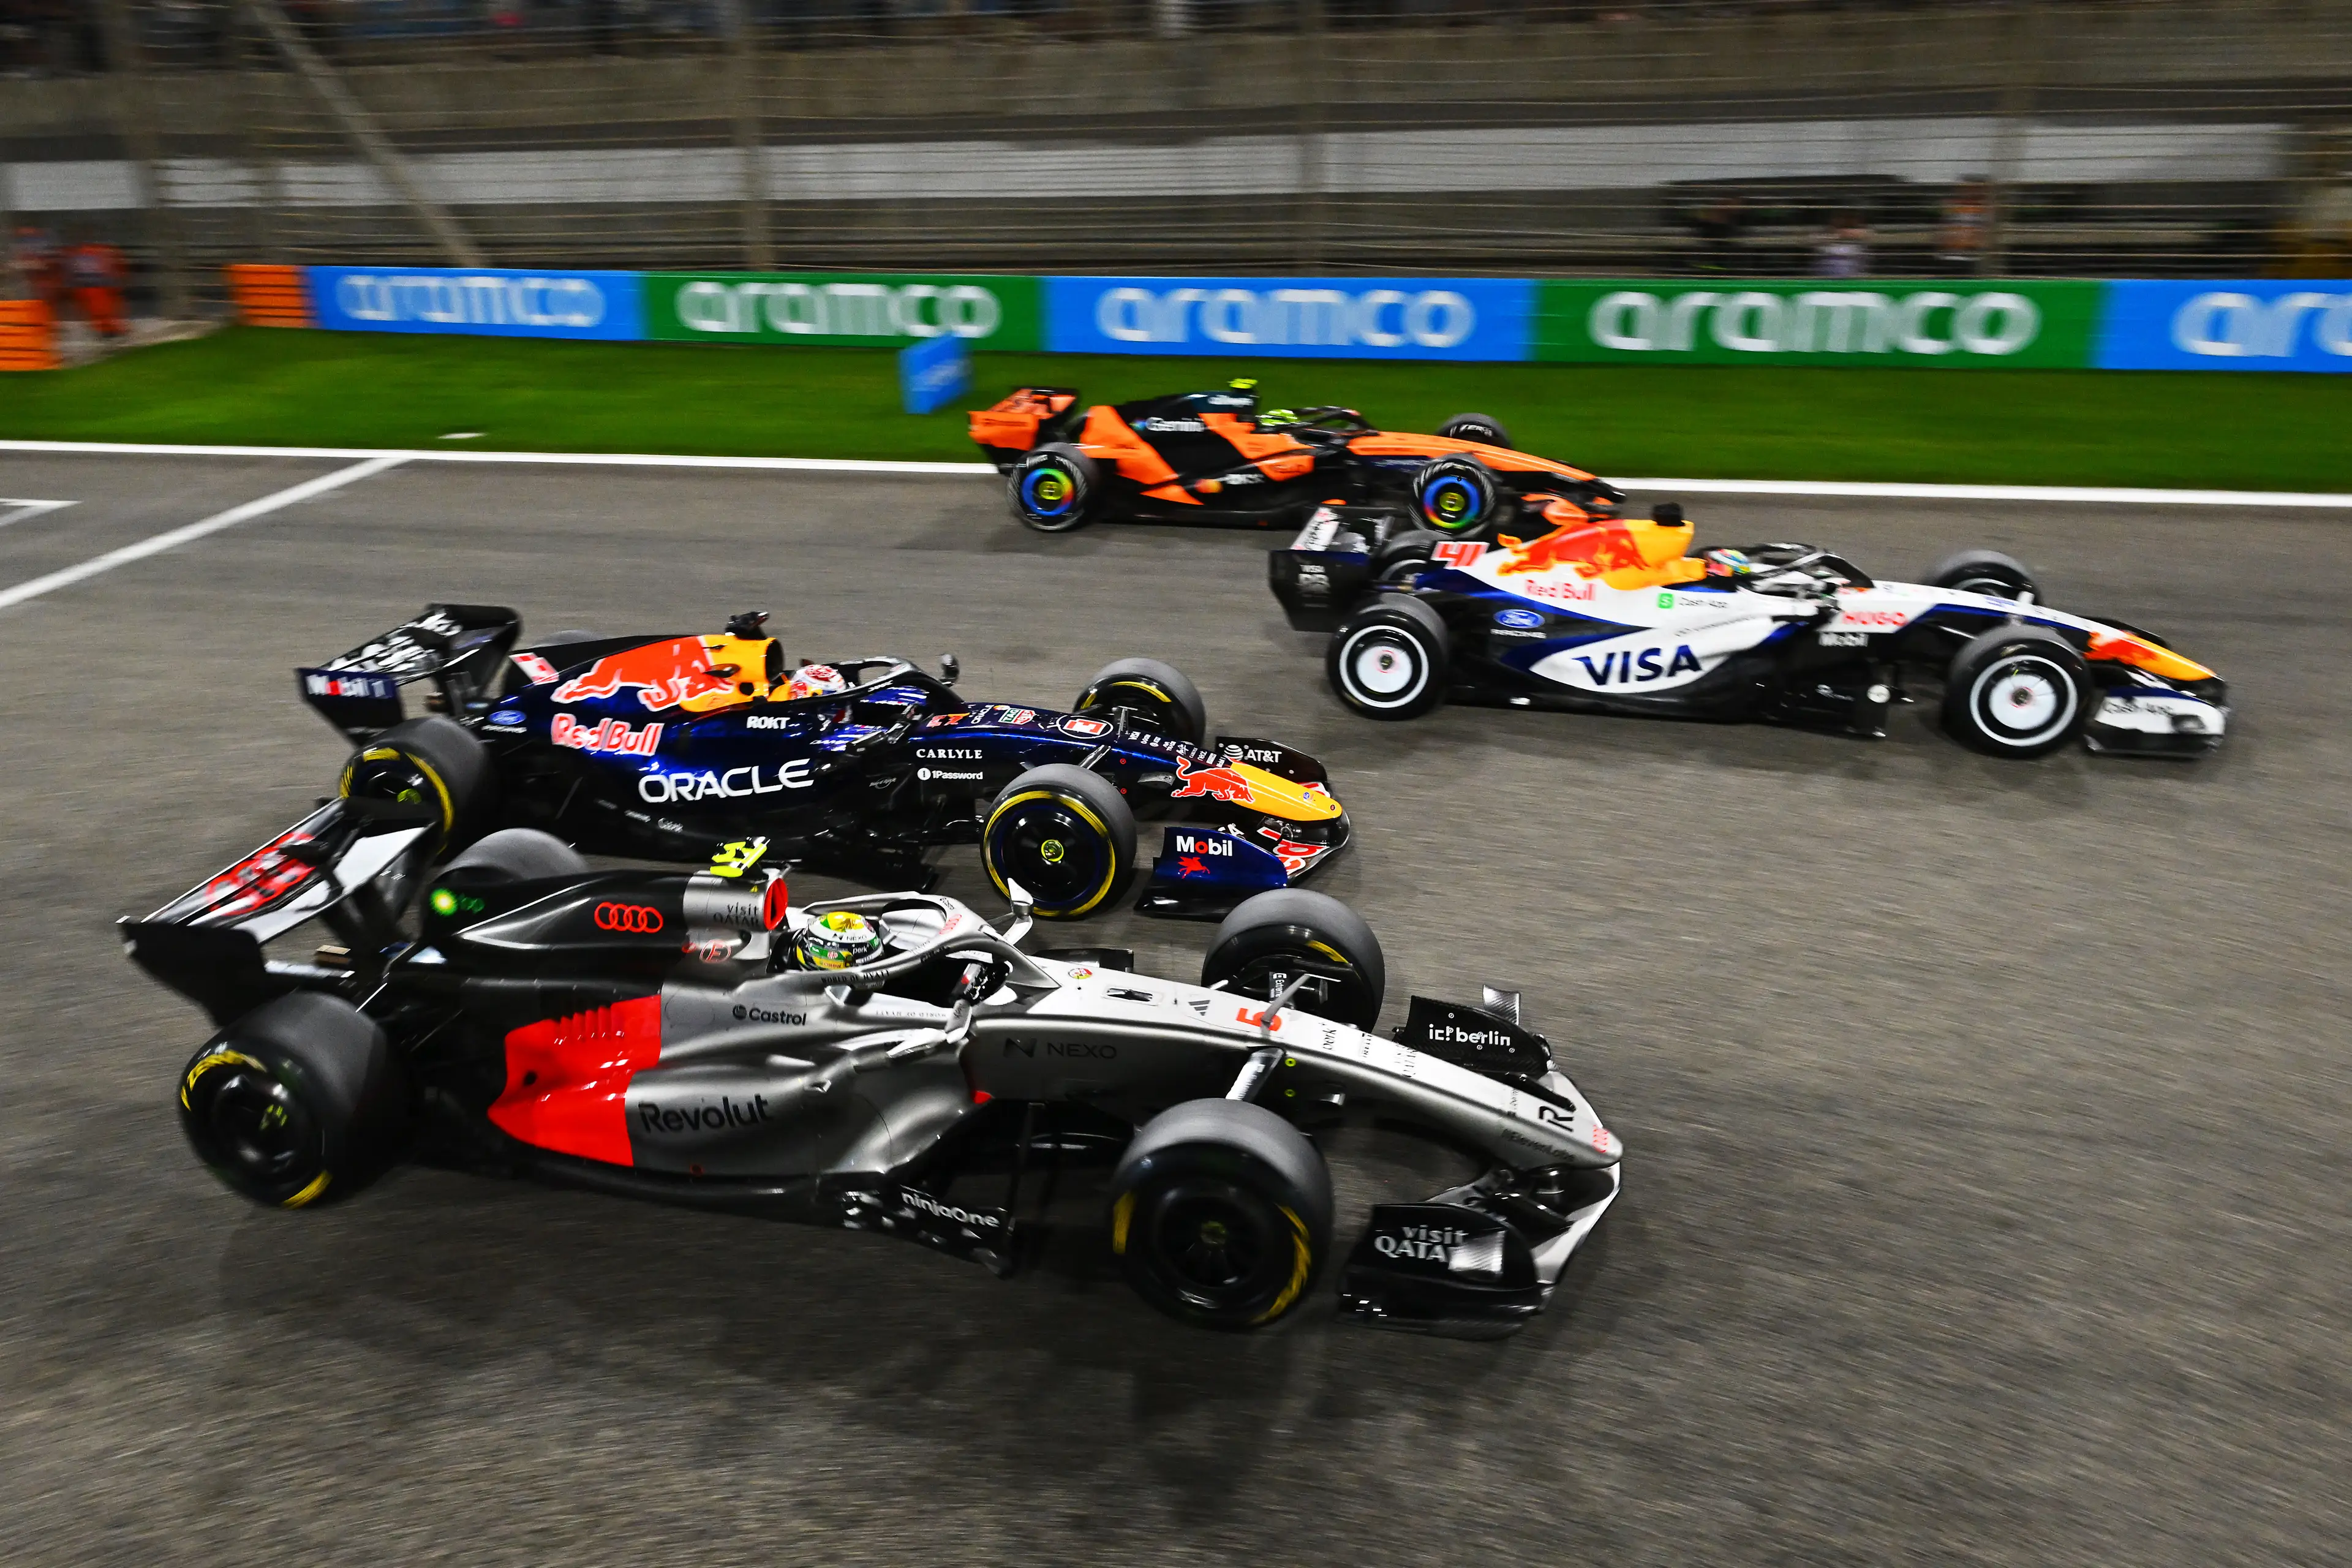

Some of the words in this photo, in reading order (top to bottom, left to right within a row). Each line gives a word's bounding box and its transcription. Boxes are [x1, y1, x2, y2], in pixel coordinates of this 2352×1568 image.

[676, 281, 1001, 338] aramco
[1095, 286, 1476, 347] aramco
[1588, 290, 2041, 355] aramco
[1525, 579, 1559, 598] Red
[1561, 582, 1597, 601] Bull
[1572, 644, 1702, 686] VISA
[747, 715, 791, 729] ROKT
[1002, 709, 1021, 722] TAG
[551, 712, 612, 752] Red
[606, 718, 665, 757] Bull
[1128, 731, 1141, 741] VISA
[916, 748, 983, 759] CARLYLE
[1247, 749, 1283, 763] AT&T
[638, 758, 815, 804] ORACLE
[932, 770, 984, 780] 1Password
[1176, 835, 1233, 857] Mobil
[727, 901, 760, 916] visit
[749, 1007, 807, 1026] Castrol
[1235, 1008, 1282, 1031] 5
[1455, 1027, 1511, 1047] berlin
[1047, 1042, 1117, 1059] NEXO
[638, 1093, 774, 1134] Revolut
[901, 1191, 1000, 1227] ninjaOne
[1401, 1224, 1469, 1245] visit
[1374, 1235, 1449, 1263] QATA
